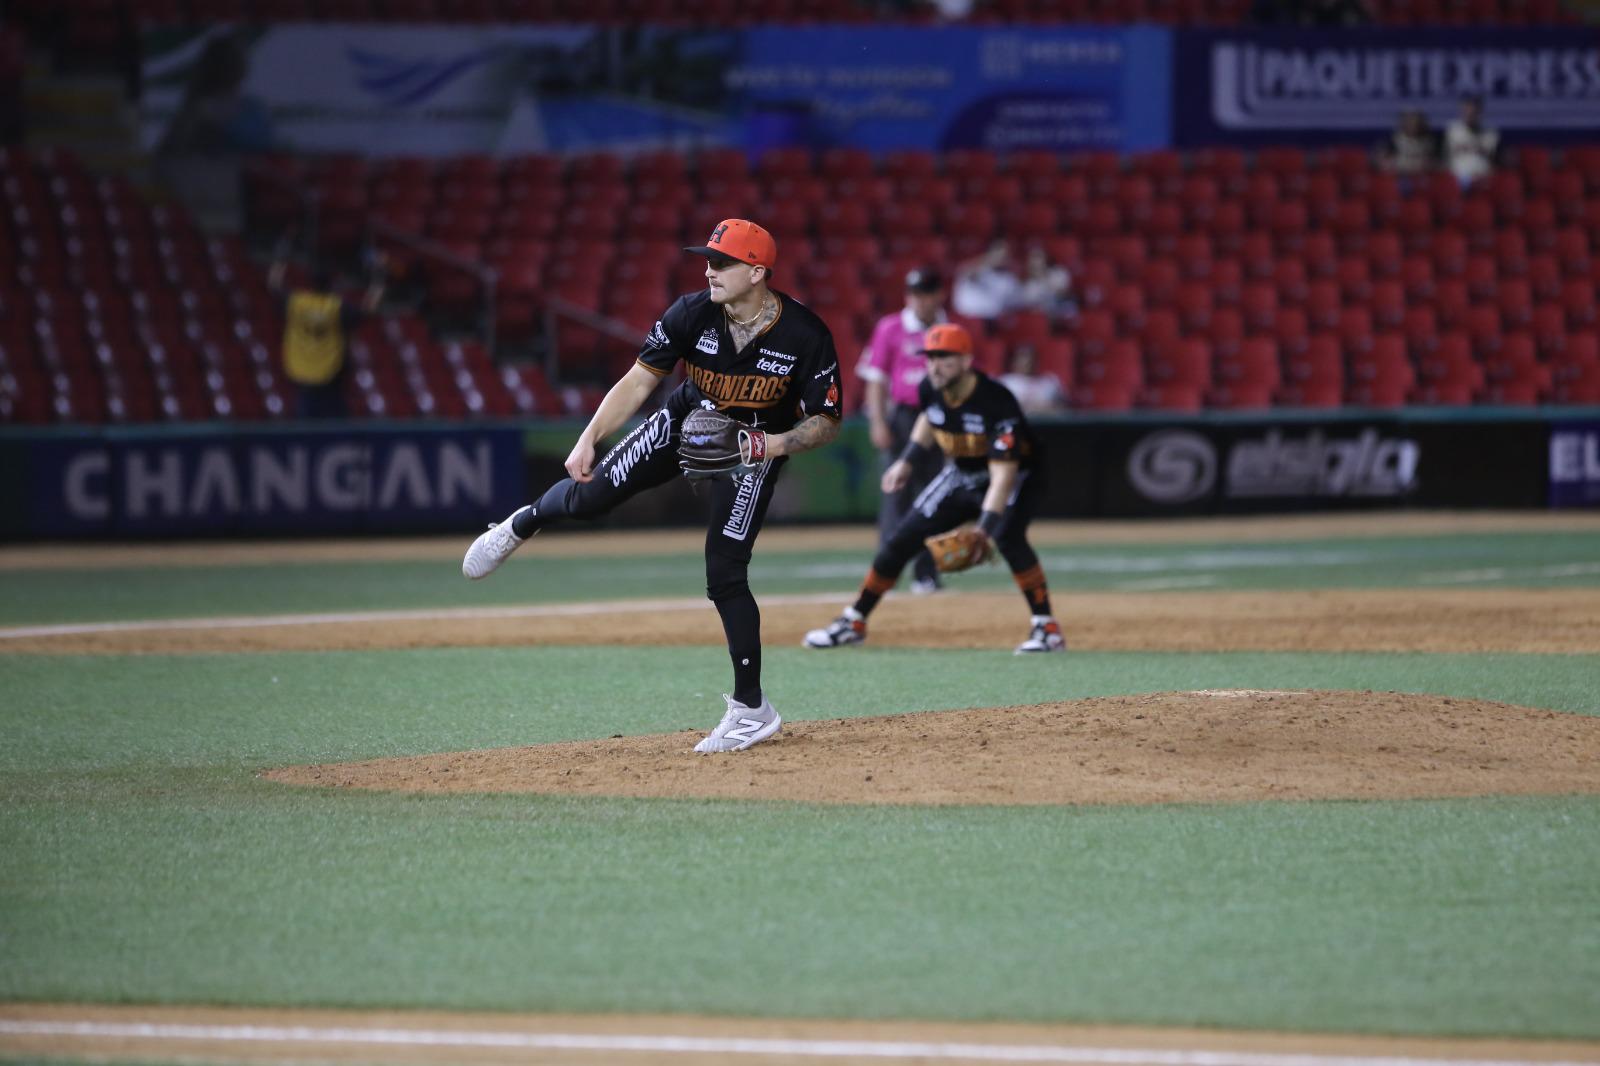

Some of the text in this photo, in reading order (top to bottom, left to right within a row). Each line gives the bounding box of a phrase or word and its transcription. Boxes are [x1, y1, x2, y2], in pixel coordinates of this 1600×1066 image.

[1260, 46, 1600, 97] PAQUETEXPRESS
[756, 357, 794, 375] telcel
[62, 440, 497, 519] CHANGAN
